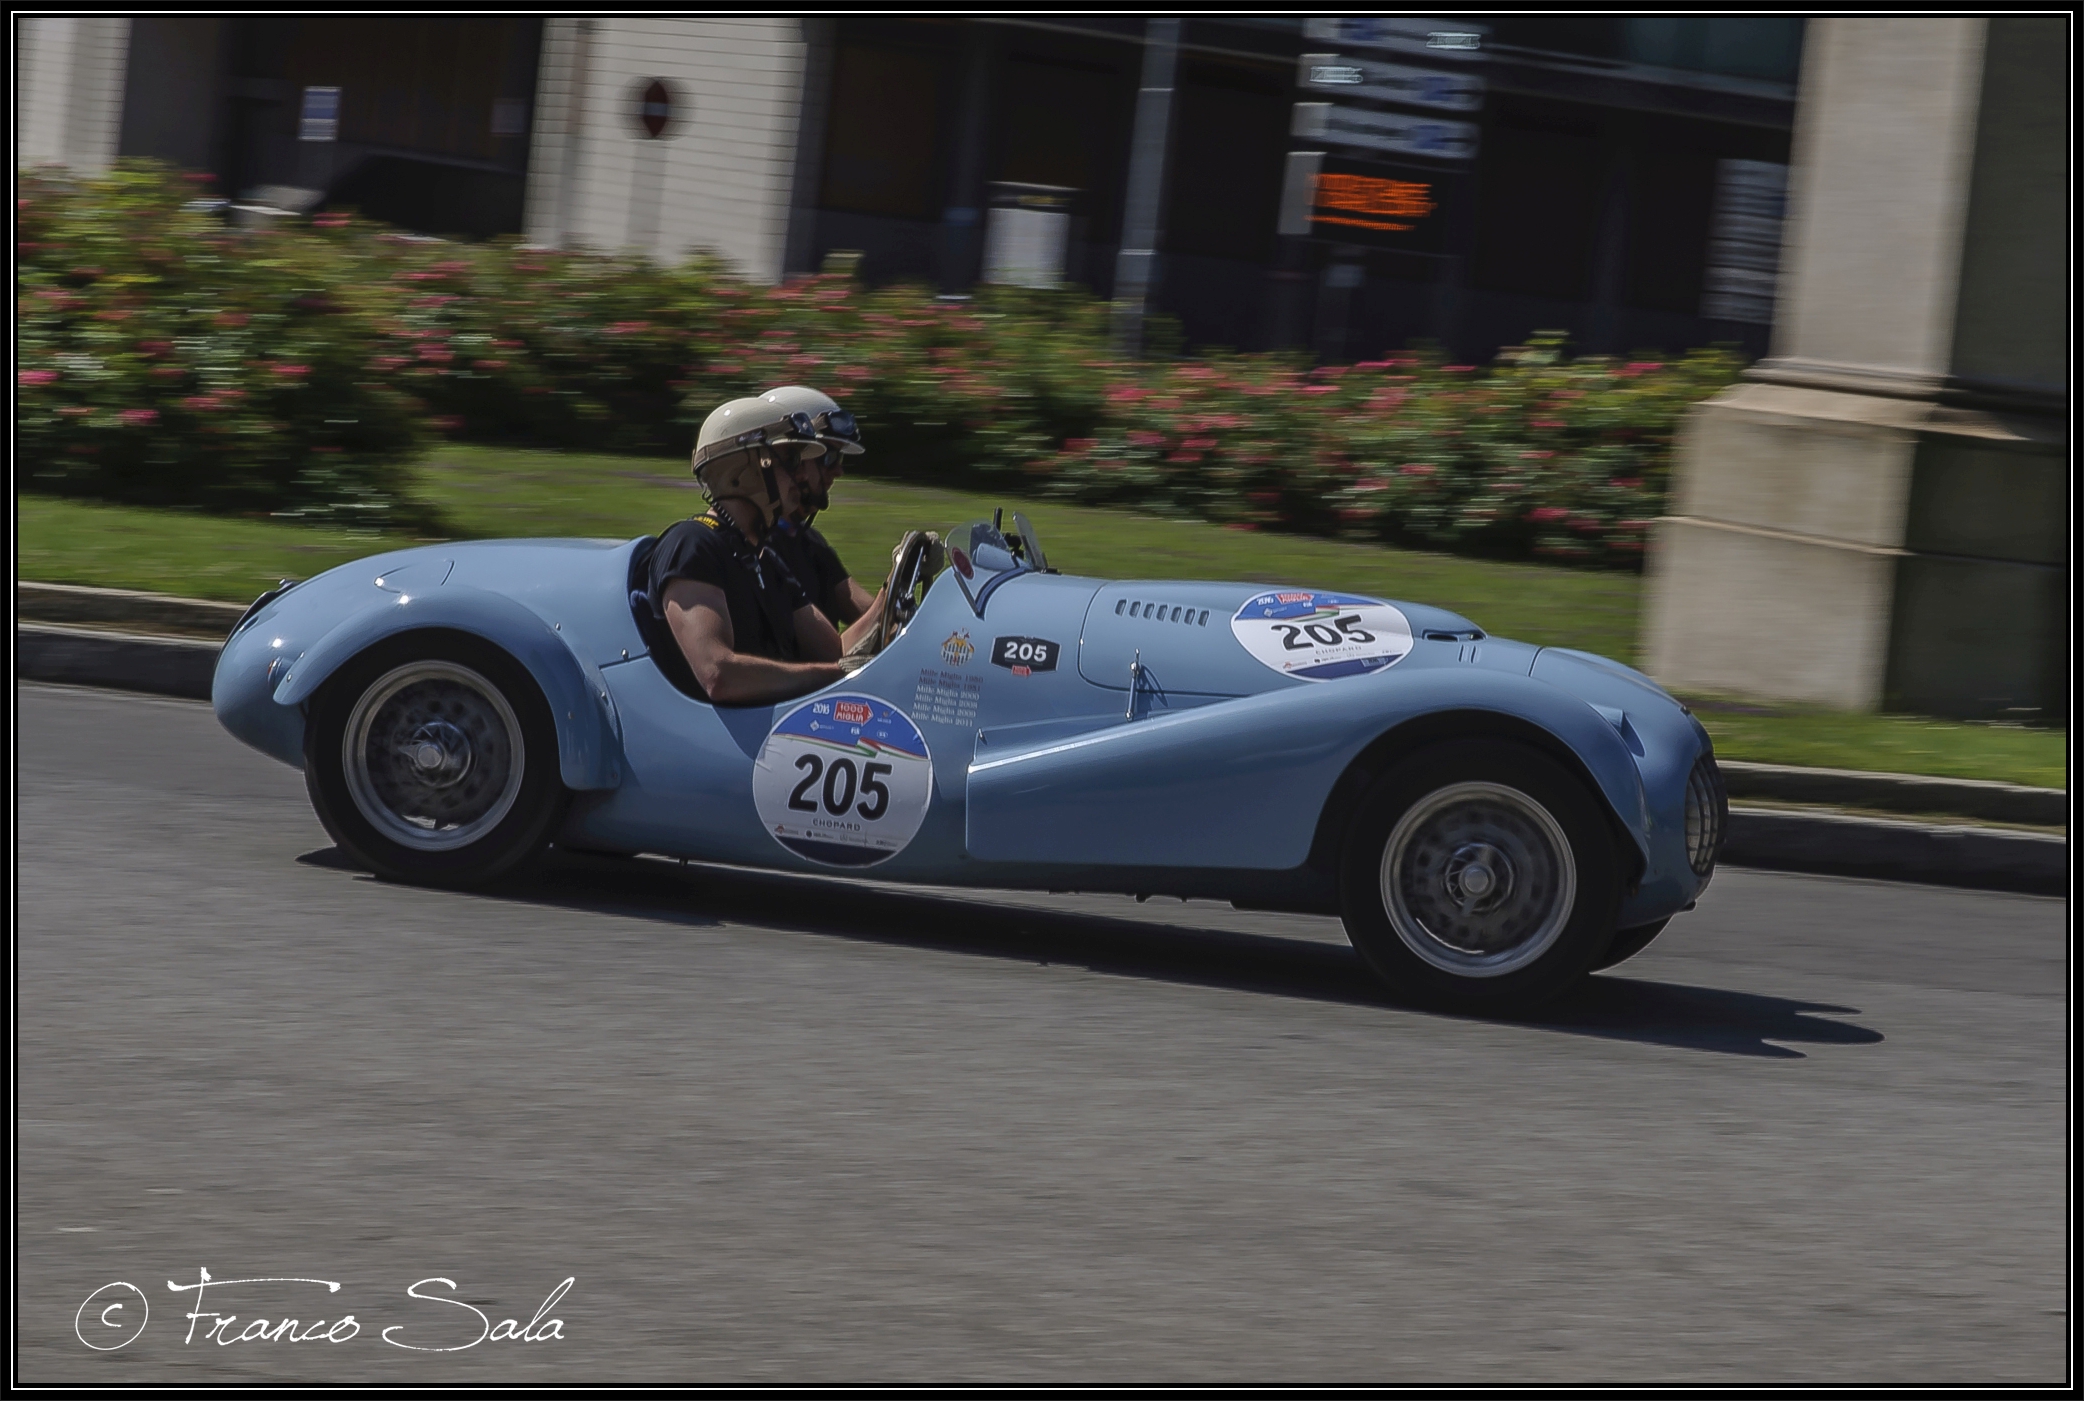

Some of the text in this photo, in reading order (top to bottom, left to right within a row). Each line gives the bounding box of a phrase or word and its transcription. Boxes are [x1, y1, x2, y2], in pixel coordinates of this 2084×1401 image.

[1271, 614, 1376, 651] 205
[1004, 641, 1047, 662] 205
[921, 668, 938, 676] Mille
[919, 676, 936, 684] Mille
[916, 685, 934, 693] Mille
[936, 688, 958, 697] Miglia
[915, 694, 933, 702] Mille
[935, 696, 956, 706] Miglia
[840, 703, 863, 713] 1000
[913, 702, 931, 711] Mille
[933, 705, 955, 715] Miglia
[836, 712, 863, 722] MIGLIA
[911, 711, 929, 720] Mille
[931, 714, 953, 724] Miglia
[788, 753, 893, 821] 205
[812, 818, 861, 831] CHOPARD
